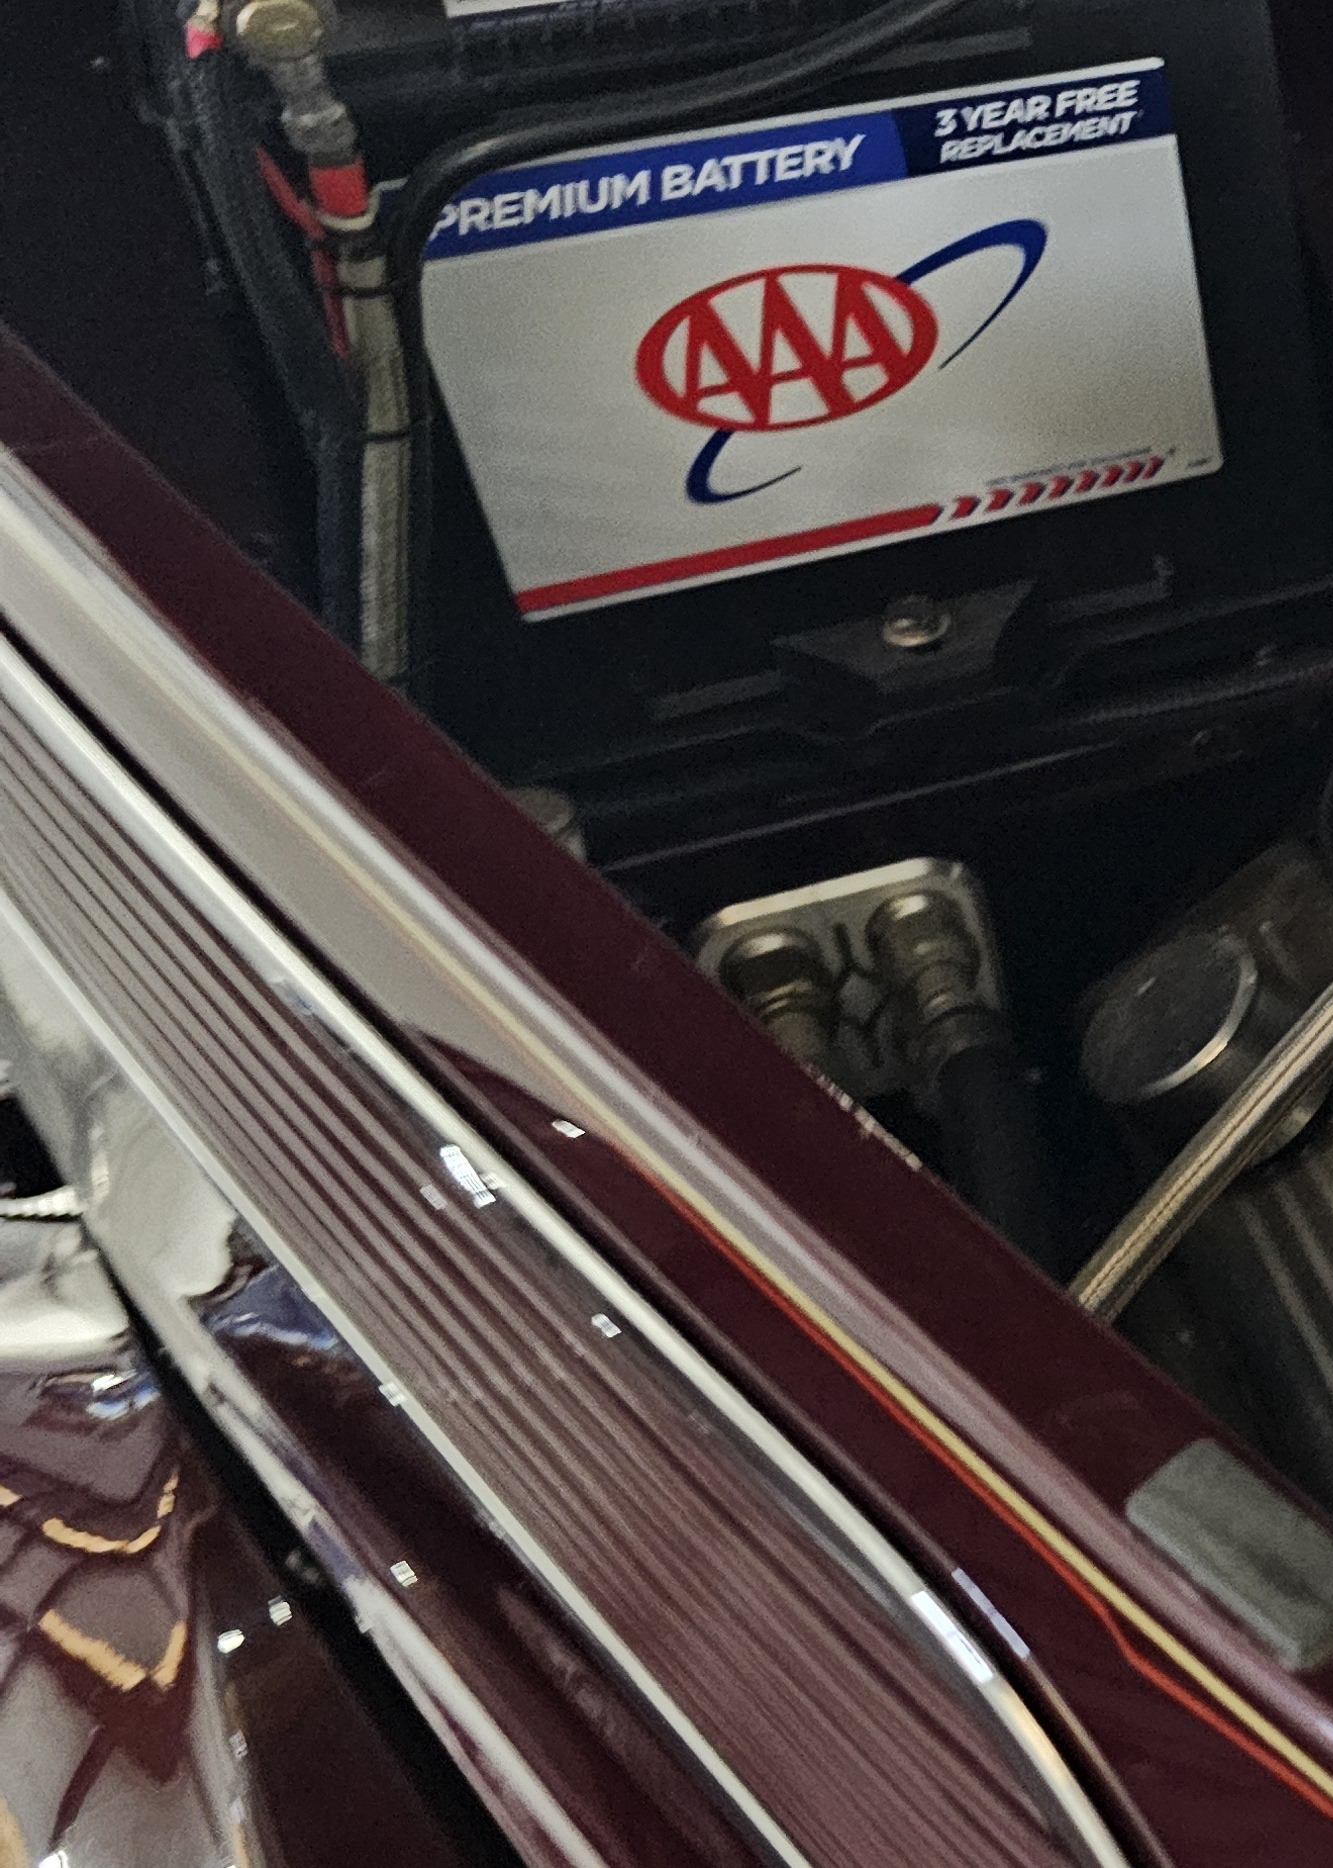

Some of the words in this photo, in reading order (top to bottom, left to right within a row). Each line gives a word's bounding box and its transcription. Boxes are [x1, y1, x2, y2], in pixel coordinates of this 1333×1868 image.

[934, 108, 958, 138] 3
[960, 94, 1053, 132] YEAR
[1054, 79, 1142, 119] FREE
[939, 111, 1138, 164] REPLACEMENT
[427, 169, 652, 242] PREMIUM
[659, 133, 867, 202] BATTERY
[652, 265, 930, 431] AAA
